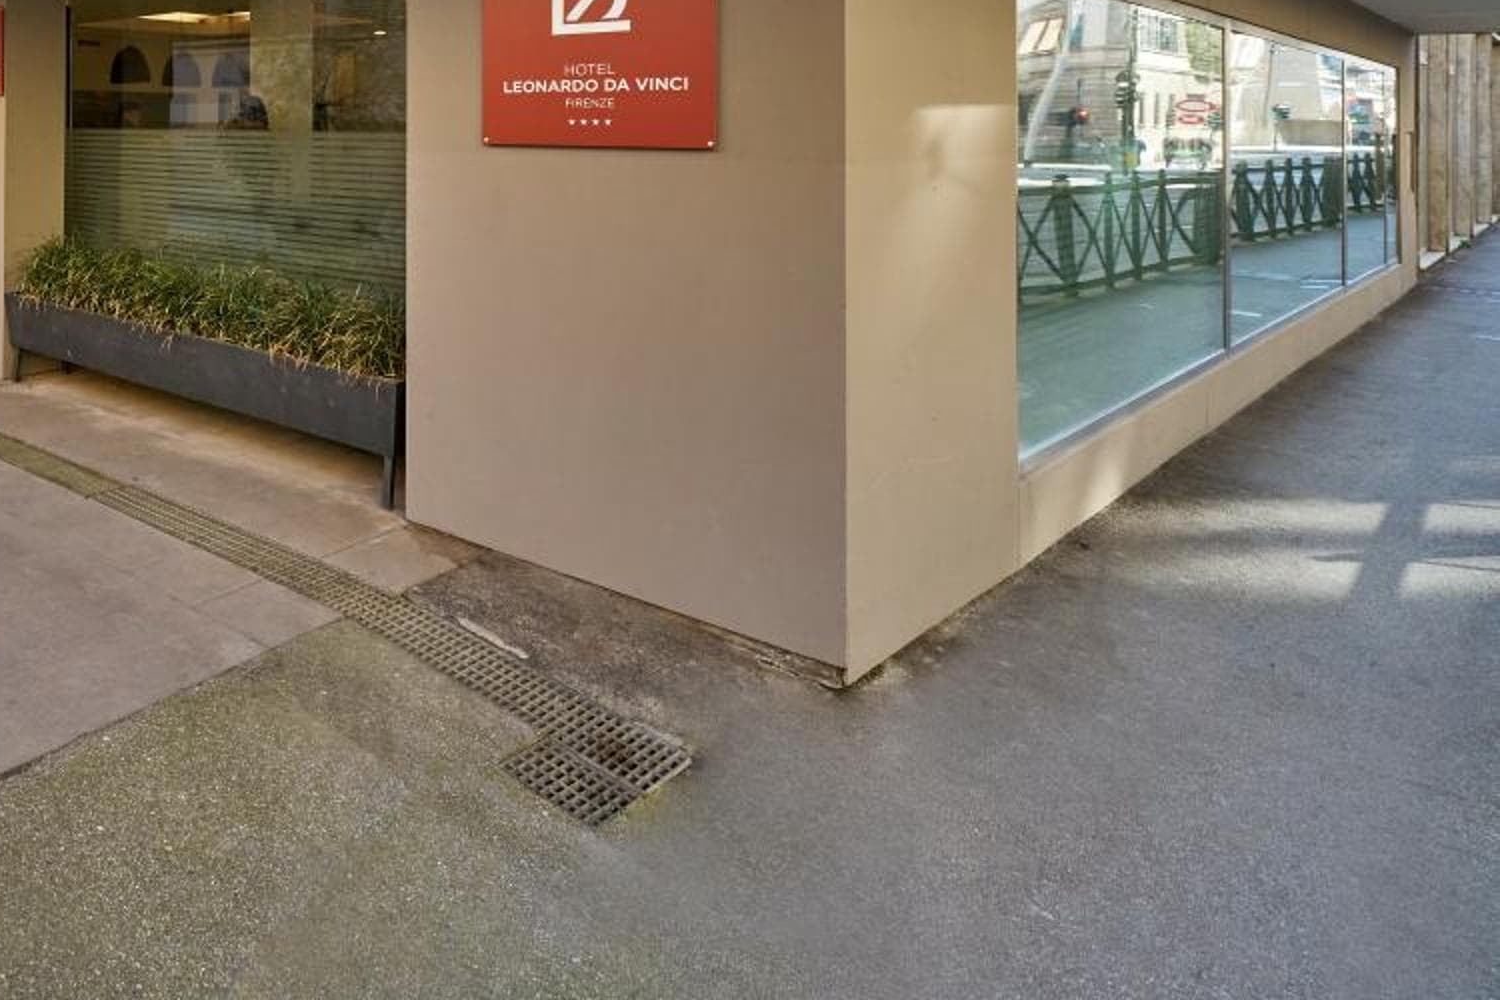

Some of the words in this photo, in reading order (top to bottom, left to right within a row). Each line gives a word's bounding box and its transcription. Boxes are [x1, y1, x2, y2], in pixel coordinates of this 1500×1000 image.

[563, 63, 616, 77] HOTEL
[502, 79, 599, 94] LEONARDO
[603, 78, 630, 92] DA
[635, 76, 690, 91] VINCI
[565, 97, 616, 109] FIRENZE
